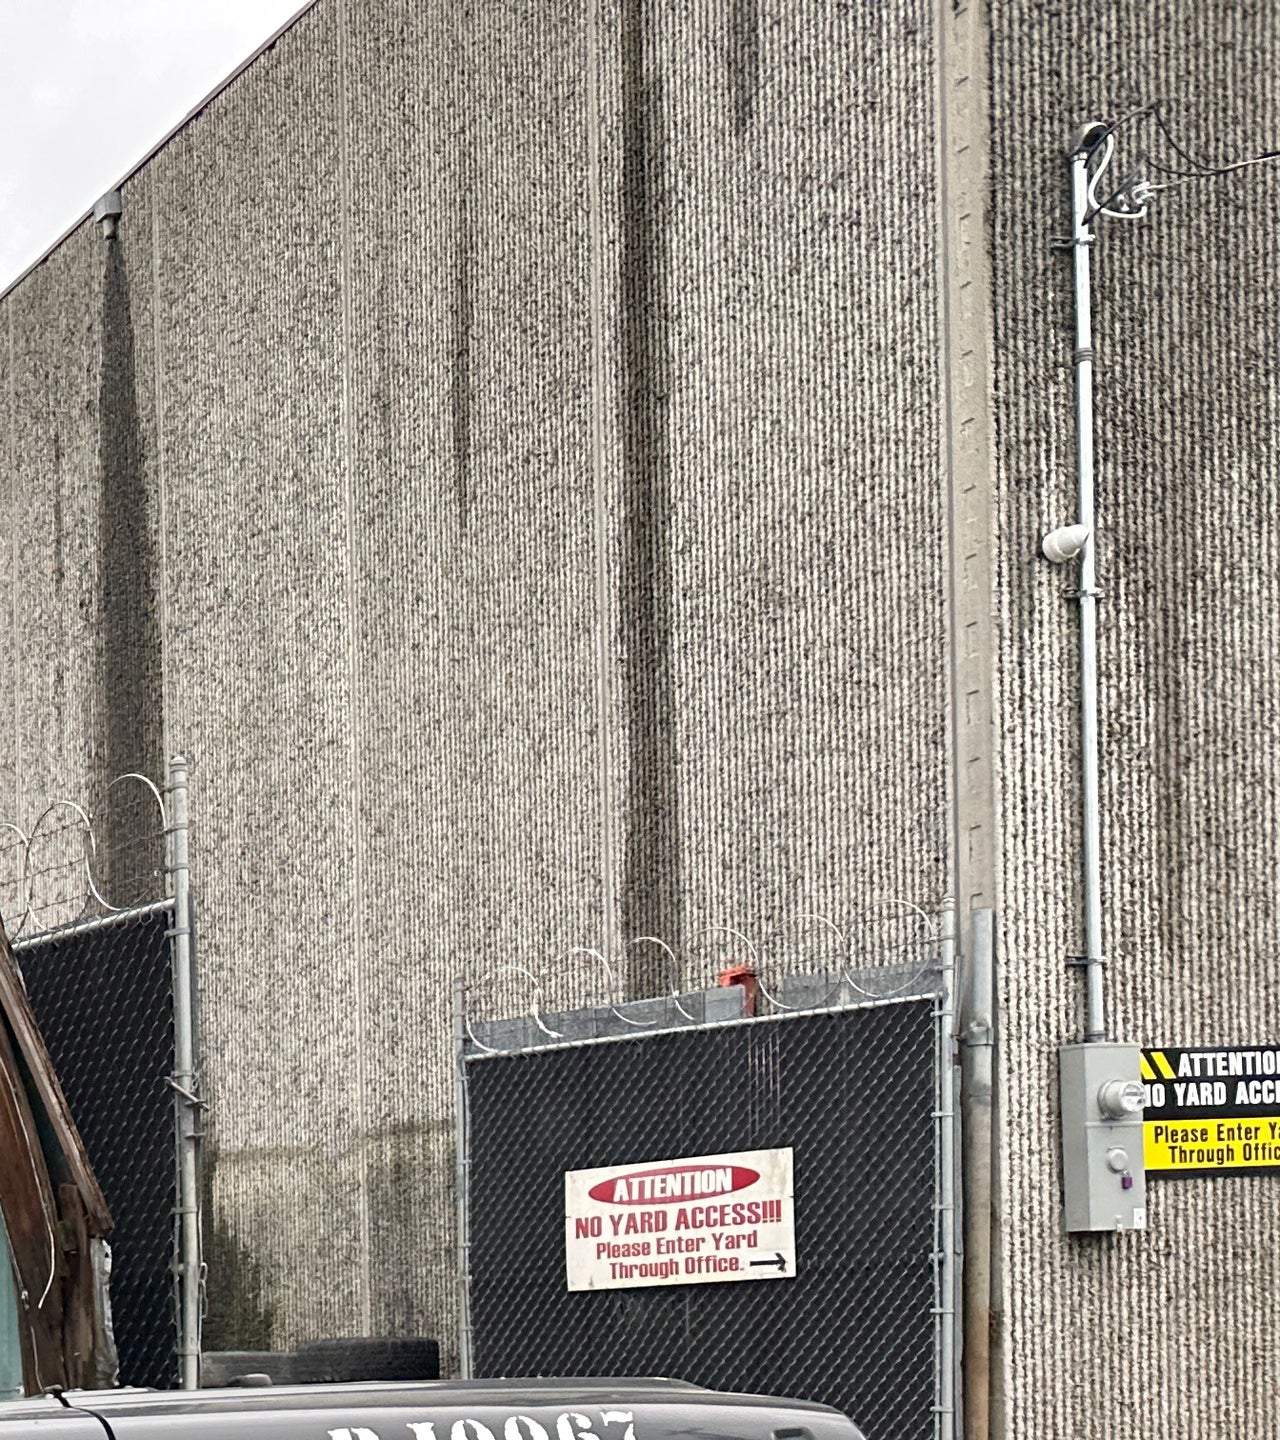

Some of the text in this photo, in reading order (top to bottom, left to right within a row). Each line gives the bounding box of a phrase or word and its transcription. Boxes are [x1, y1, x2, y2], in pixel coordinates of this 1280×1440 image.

[1178, 1051, 1280, 1077] ATTENTIO
[1174, 1082, 1226, 1107] YARD
[1154, 1125, 1208, 1144] Please
[1217, 1122, 1260, 1141] Enter
[1168, 1142, 1280, 1166] Through Offic
[613, 1168, 732, 1202] ATTENTION
[575, 1200, 782, 1239] NO YARD ACCESS!!!
[596, 1230, 758, 1260] Please Enter Yard
[610, 1258, 680, 1280] Through
